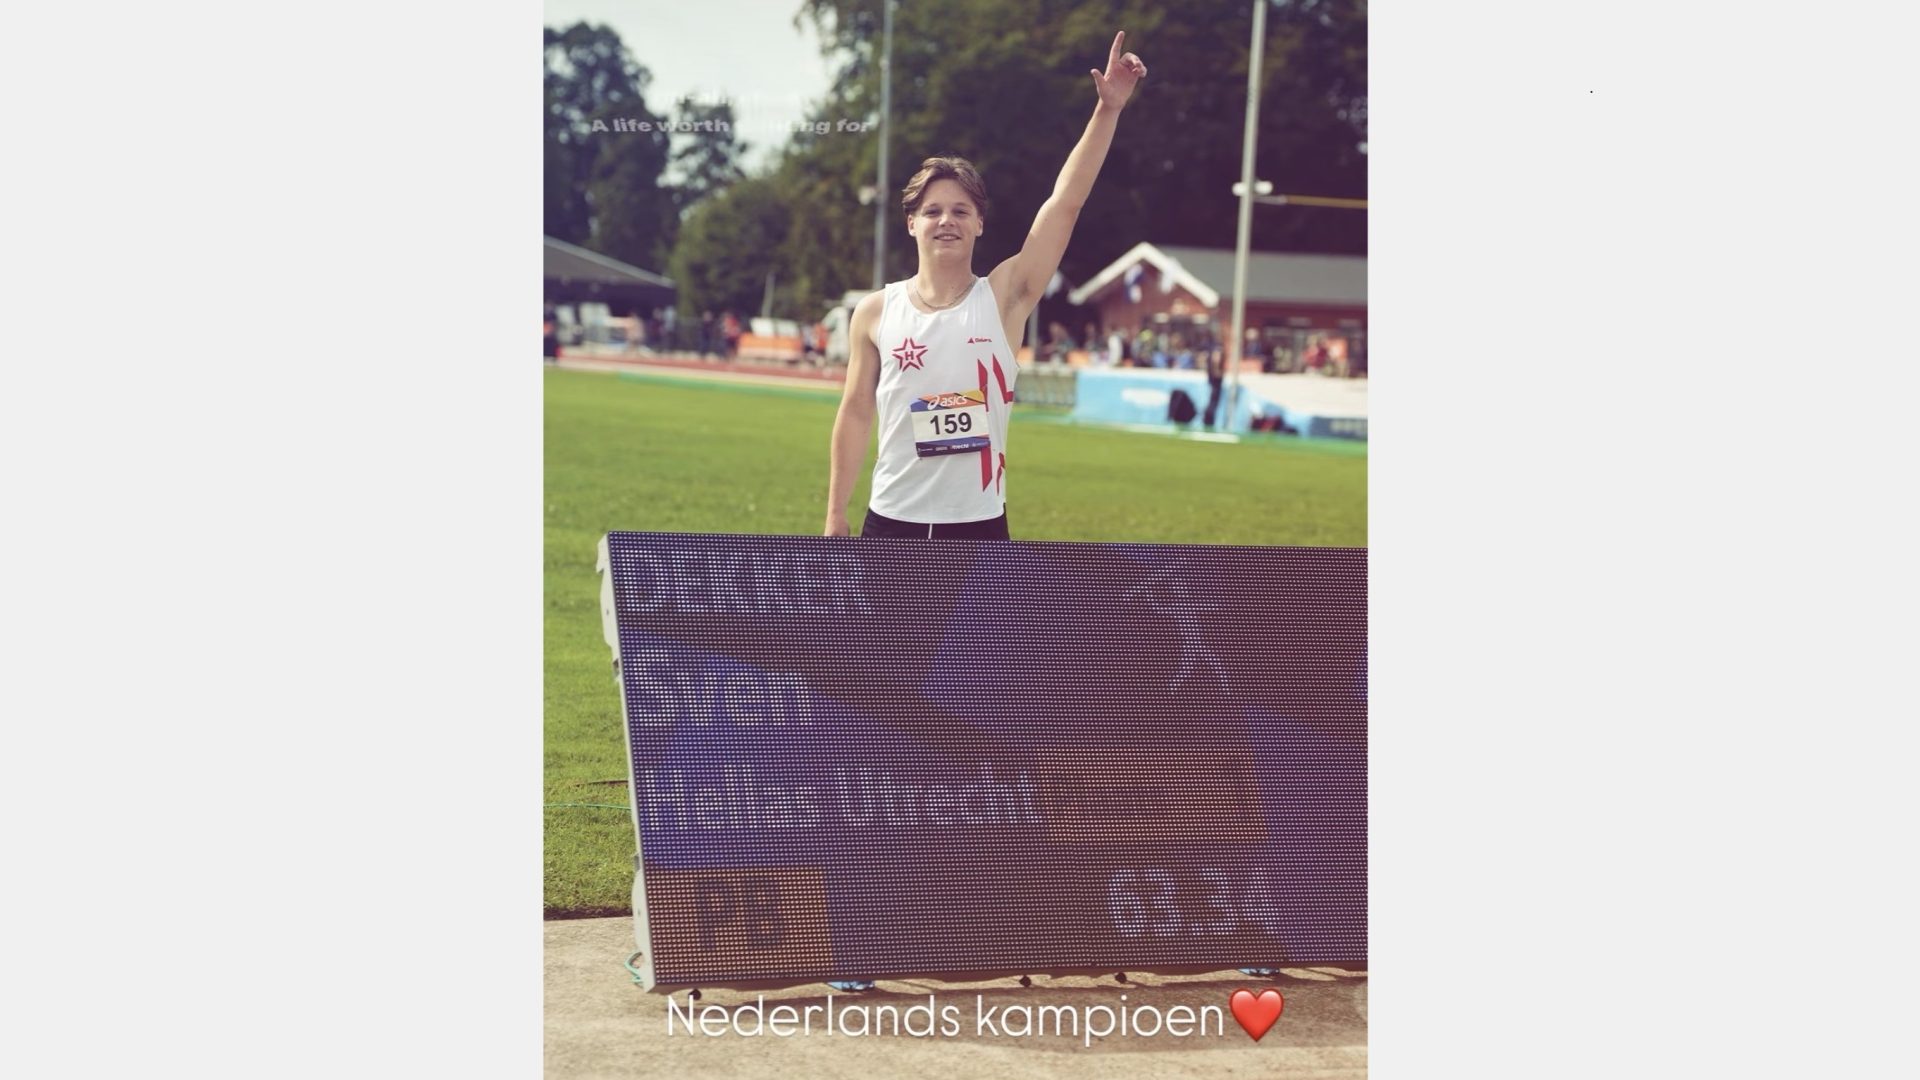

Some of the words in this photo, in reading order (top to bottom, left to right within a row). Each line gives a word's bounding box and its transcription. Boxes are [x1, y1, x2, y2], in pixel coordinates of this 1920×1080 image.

[904, 350, 915, 361] H
[929, 412, 973, 436] 159
[940, 395, 968, 407] asics
[621, 549, 872, 614] DEKKER
[632, 649, 813, 726] Sven
[644, 764, 820, 831] Hellas
[836, 761, 1041, 827] Utrecht
[694, 876, 788, 952] PB
[1109, 867, 1279, 937] 63.34
